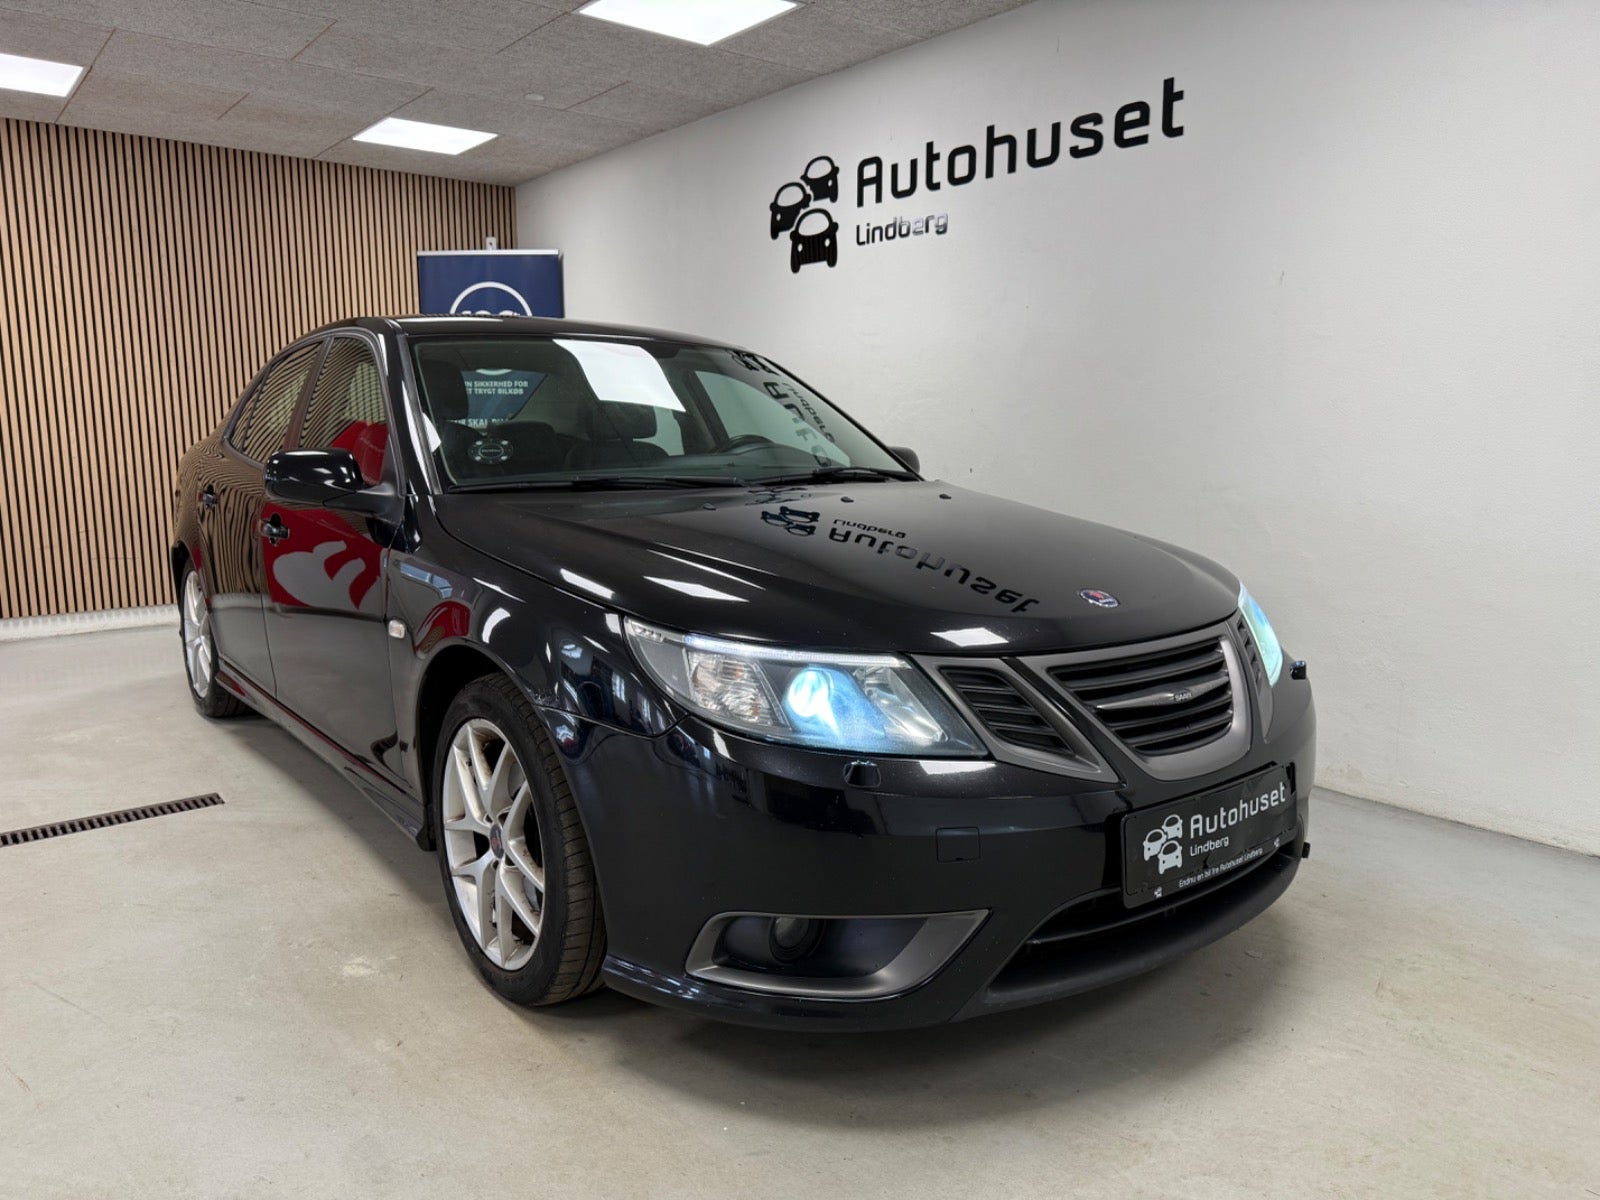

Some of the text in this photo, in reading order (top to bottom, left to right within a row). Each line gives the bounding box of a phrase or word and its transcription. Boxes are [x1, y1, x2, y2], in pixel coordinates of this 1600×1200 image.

[857, 77, 1184, 208] Autohuset
[856, 212, 949, 246] Lindberg
[474, 380, 513, 388] SIKKERHED
[514, 380, 529, 388] FOR
[1190, 781, 1286, 839] Autohuset
[1190, 836, 1229, 857] Lindberg
[1179, 876, 1196, 888] Endnu
[1220, 855, 1243, 871] Autohuset
[1244, 847, 1263, 861] Lindberg
